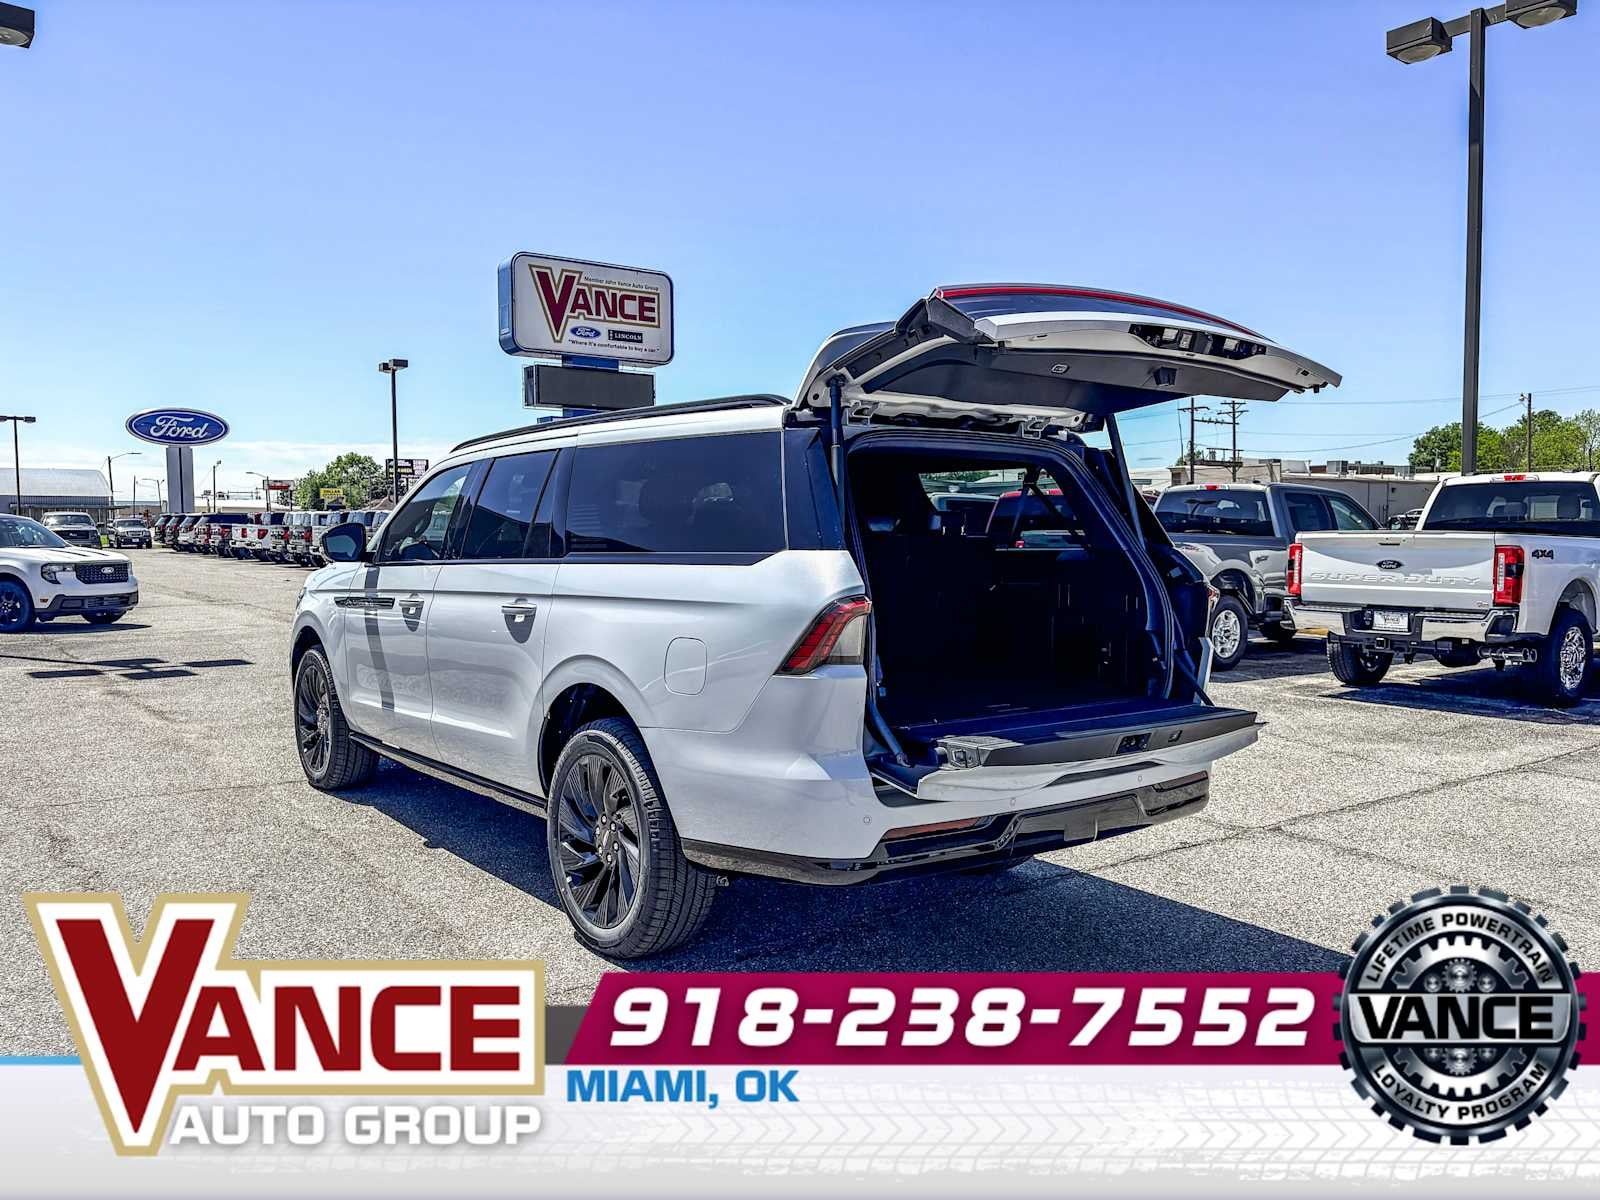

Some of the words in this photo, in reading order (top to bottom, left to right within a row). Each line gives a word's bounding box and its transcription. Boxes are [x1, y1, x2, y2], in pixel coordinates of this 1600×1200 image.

[617, 280, 632, 288] Vance
[632, 282, 644, 290] Auto
[535, 269, 656, 337] VANCE
[575, 327, 596, 338] Ford
[614, 332, 642, 341] LINCOLN
[597, 342, 628, 350] comfortable
[150, 415, 209, 438] Ford
[1310, 571, 1399, 584] SUPER
[1403, 573, 1481, 586] DUTY
